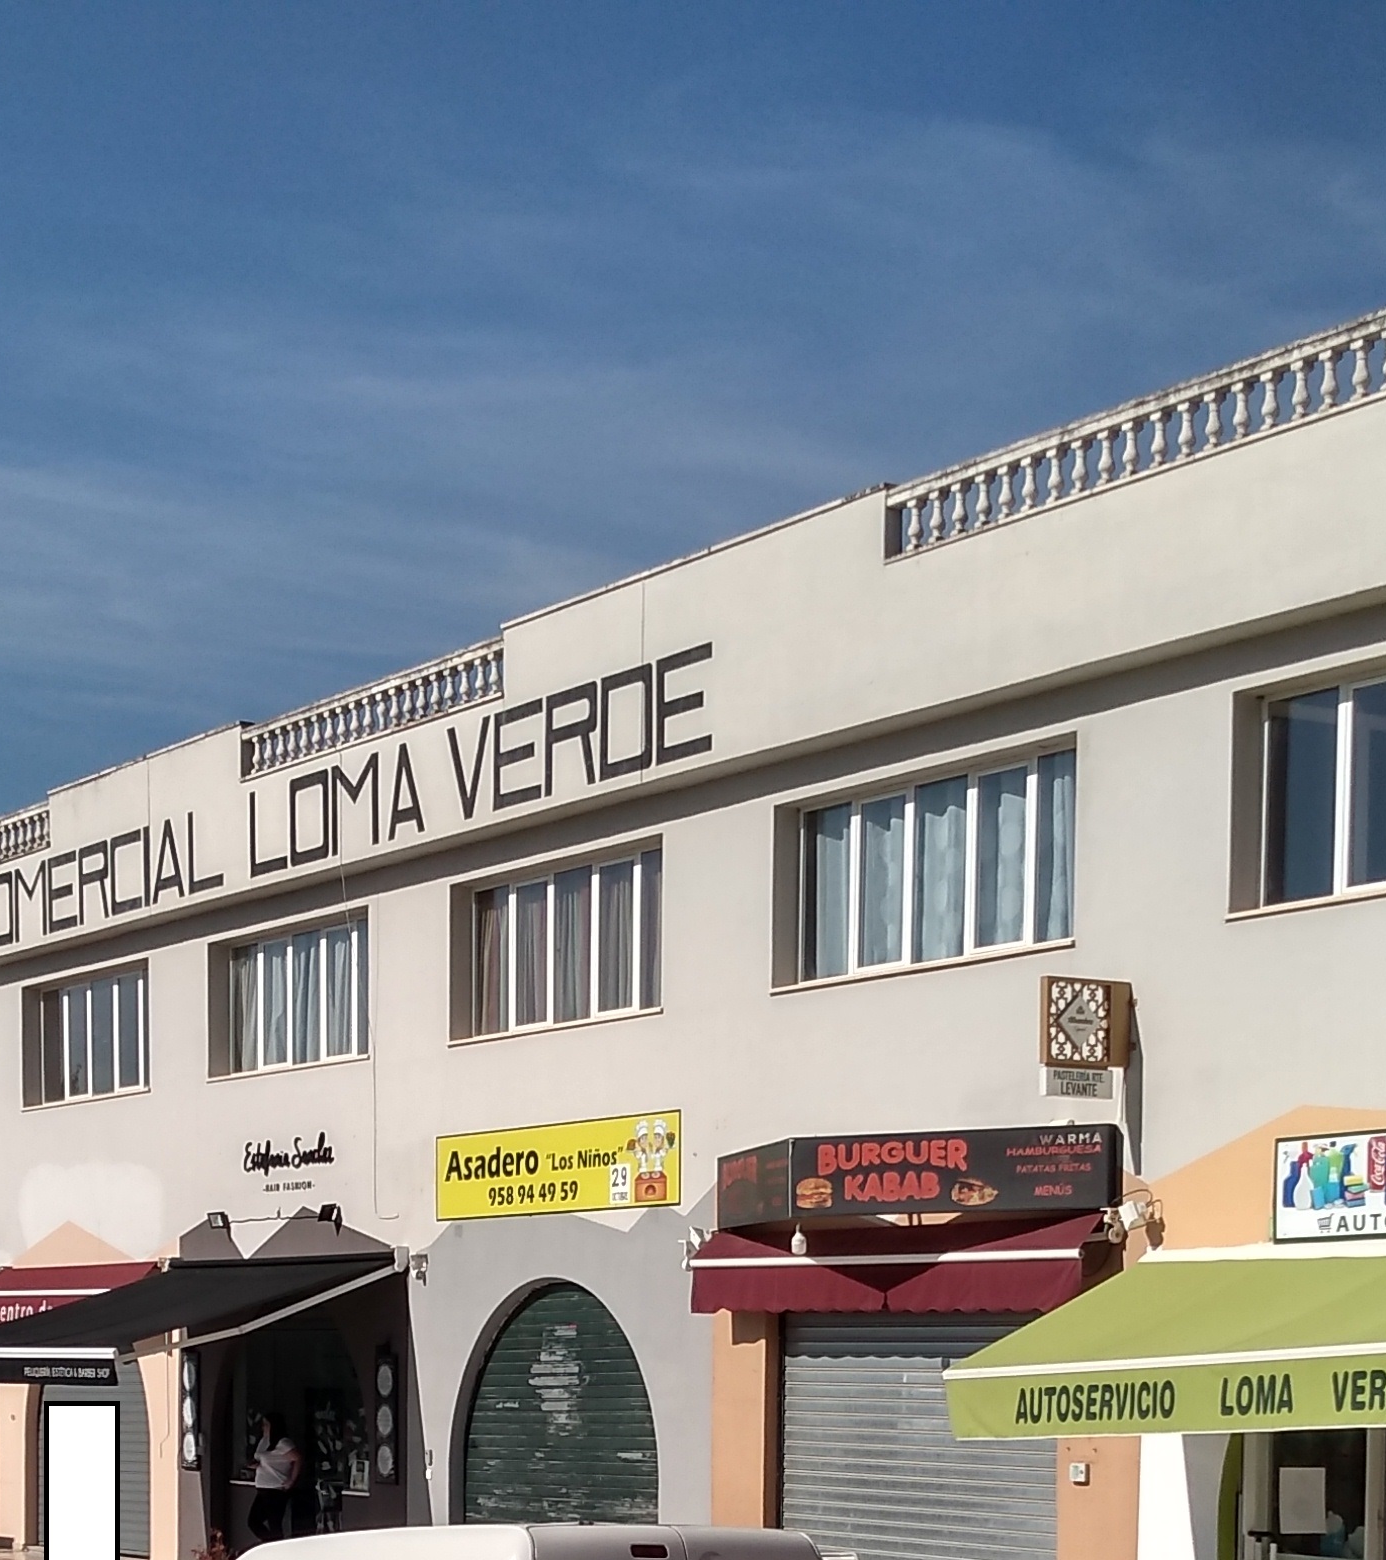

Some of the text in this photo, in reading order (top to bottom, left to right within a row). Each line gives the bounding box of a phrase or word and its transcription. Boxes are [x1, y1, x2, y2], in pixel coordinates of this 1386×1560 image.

[248, 742, 426, 879] LOMA
[446, 641, 714, 820] VERDE
[1060, 1081, 1098, 1097] LEVANTE
[1006, 1144, 1103, 1157] HAMBURGUESA
[1039, 1132, 1102, 1146] WARMA
[444, 1146, 540, 1183] Asadero
[817, 1139, 968, 1176] BURGUER
[1015, 1164, 1056, 1174] PATATAS
[611, 1166, 627, 1188] 29
[844, 1171, 941, 1203] KABAB
[488, 1180, 579, 1207] 958 94 49 59
[1033, 1183, 1073, 1197] MENÚS
[1015, 1379, 1176, 1425] AUTOSERVICIO
[1220, 1373, 1294, 1417] LOMA
